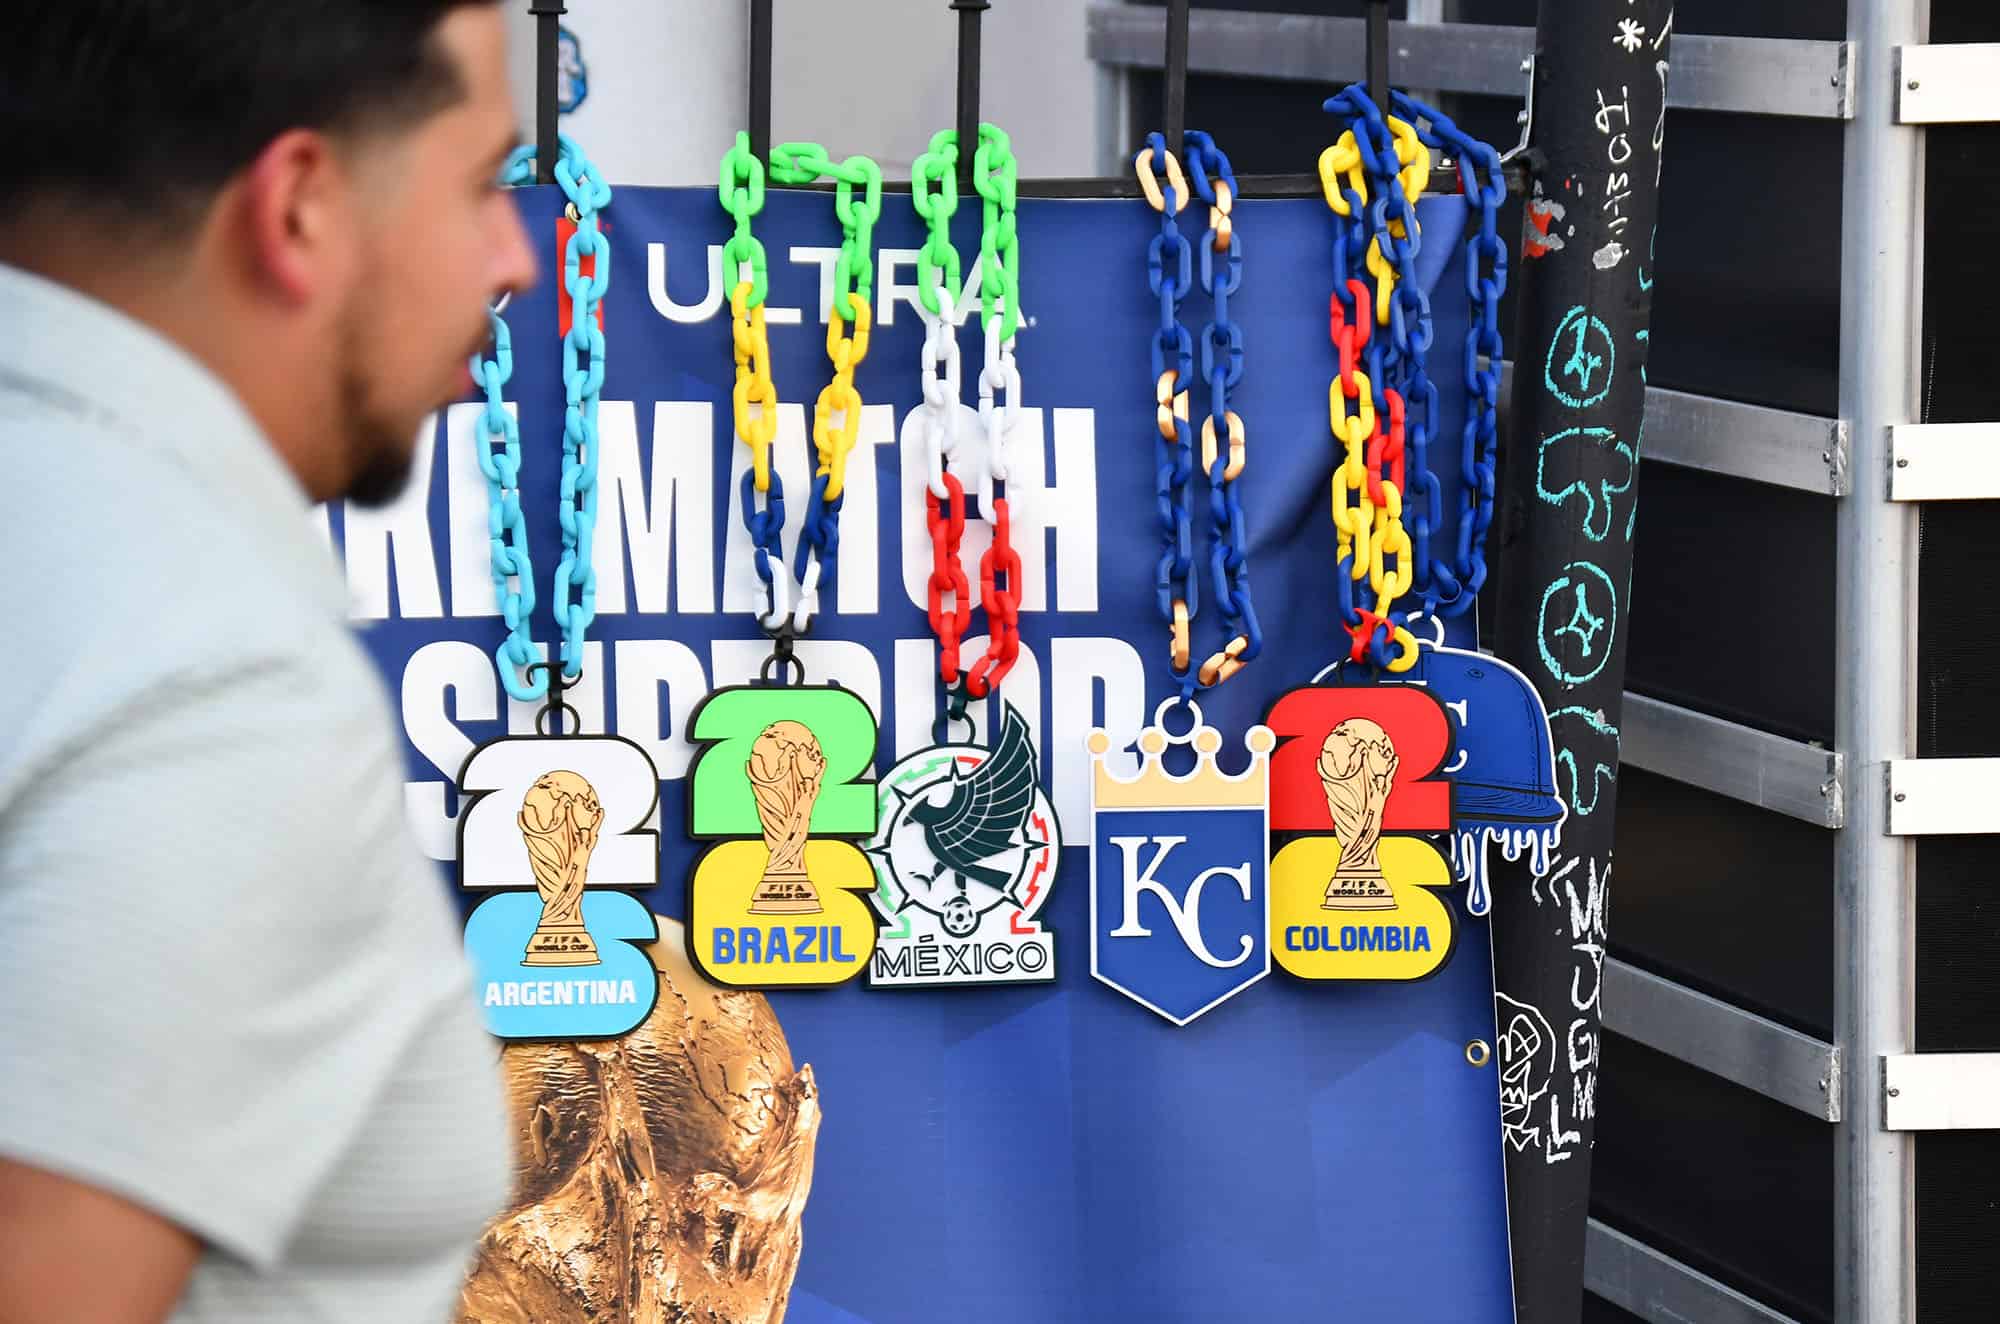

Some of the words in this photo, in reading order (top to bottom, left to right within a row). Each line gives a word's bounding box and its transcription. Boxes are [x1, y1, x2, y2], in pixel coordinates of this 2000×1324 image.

[581, 400, 1099, 614] MATCH
[767, 884, 805, 892] FIFA
[1332, 888, 1365, 896] WORLD
[1367, 888, 1385, 896] CUP
[1340, 880, 1378, 888] FIFA
[1109, 836, 1255, 968] KC
[542, 936, 581, 944] FIFA
[712, 926, 856, 964] BRAZIL
[1285, 925, 1431, 952] COLOMBIA
[874, 934, 1048, 979] MÉXICO
[484, 980, 637, 1007] ARGENTINA
